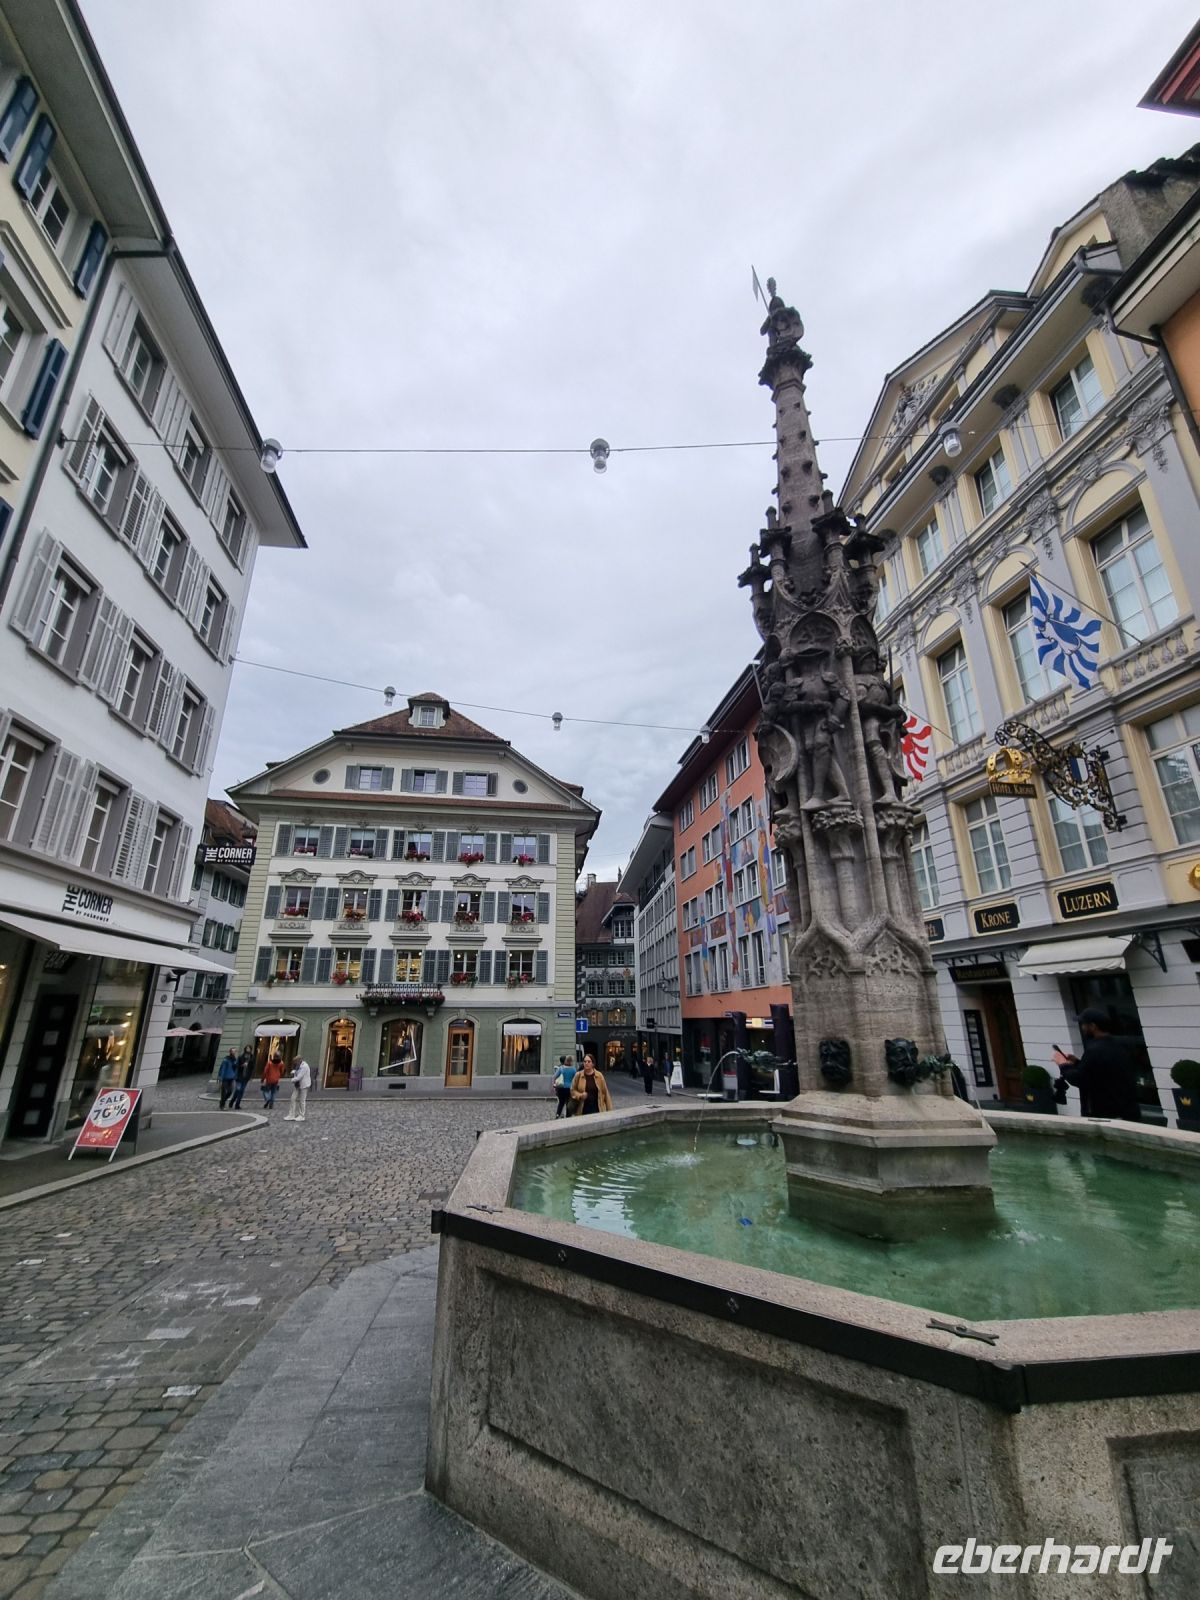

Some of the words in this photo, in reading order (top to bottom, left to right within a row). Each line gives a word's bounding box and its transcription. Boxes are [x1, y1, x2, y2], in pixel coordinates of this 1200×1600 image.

[204, 847, 218, 863] THE
[218, 847, 253, 860] CORNER
[61, 884, 81, 913] THE
[78, 888, 114, 916] CORNER
[980, 911, 1012, 928] KRONE
[1063, 890, 1112, 913] LUZERN
[99, 1094, 125, 1105] SALE
